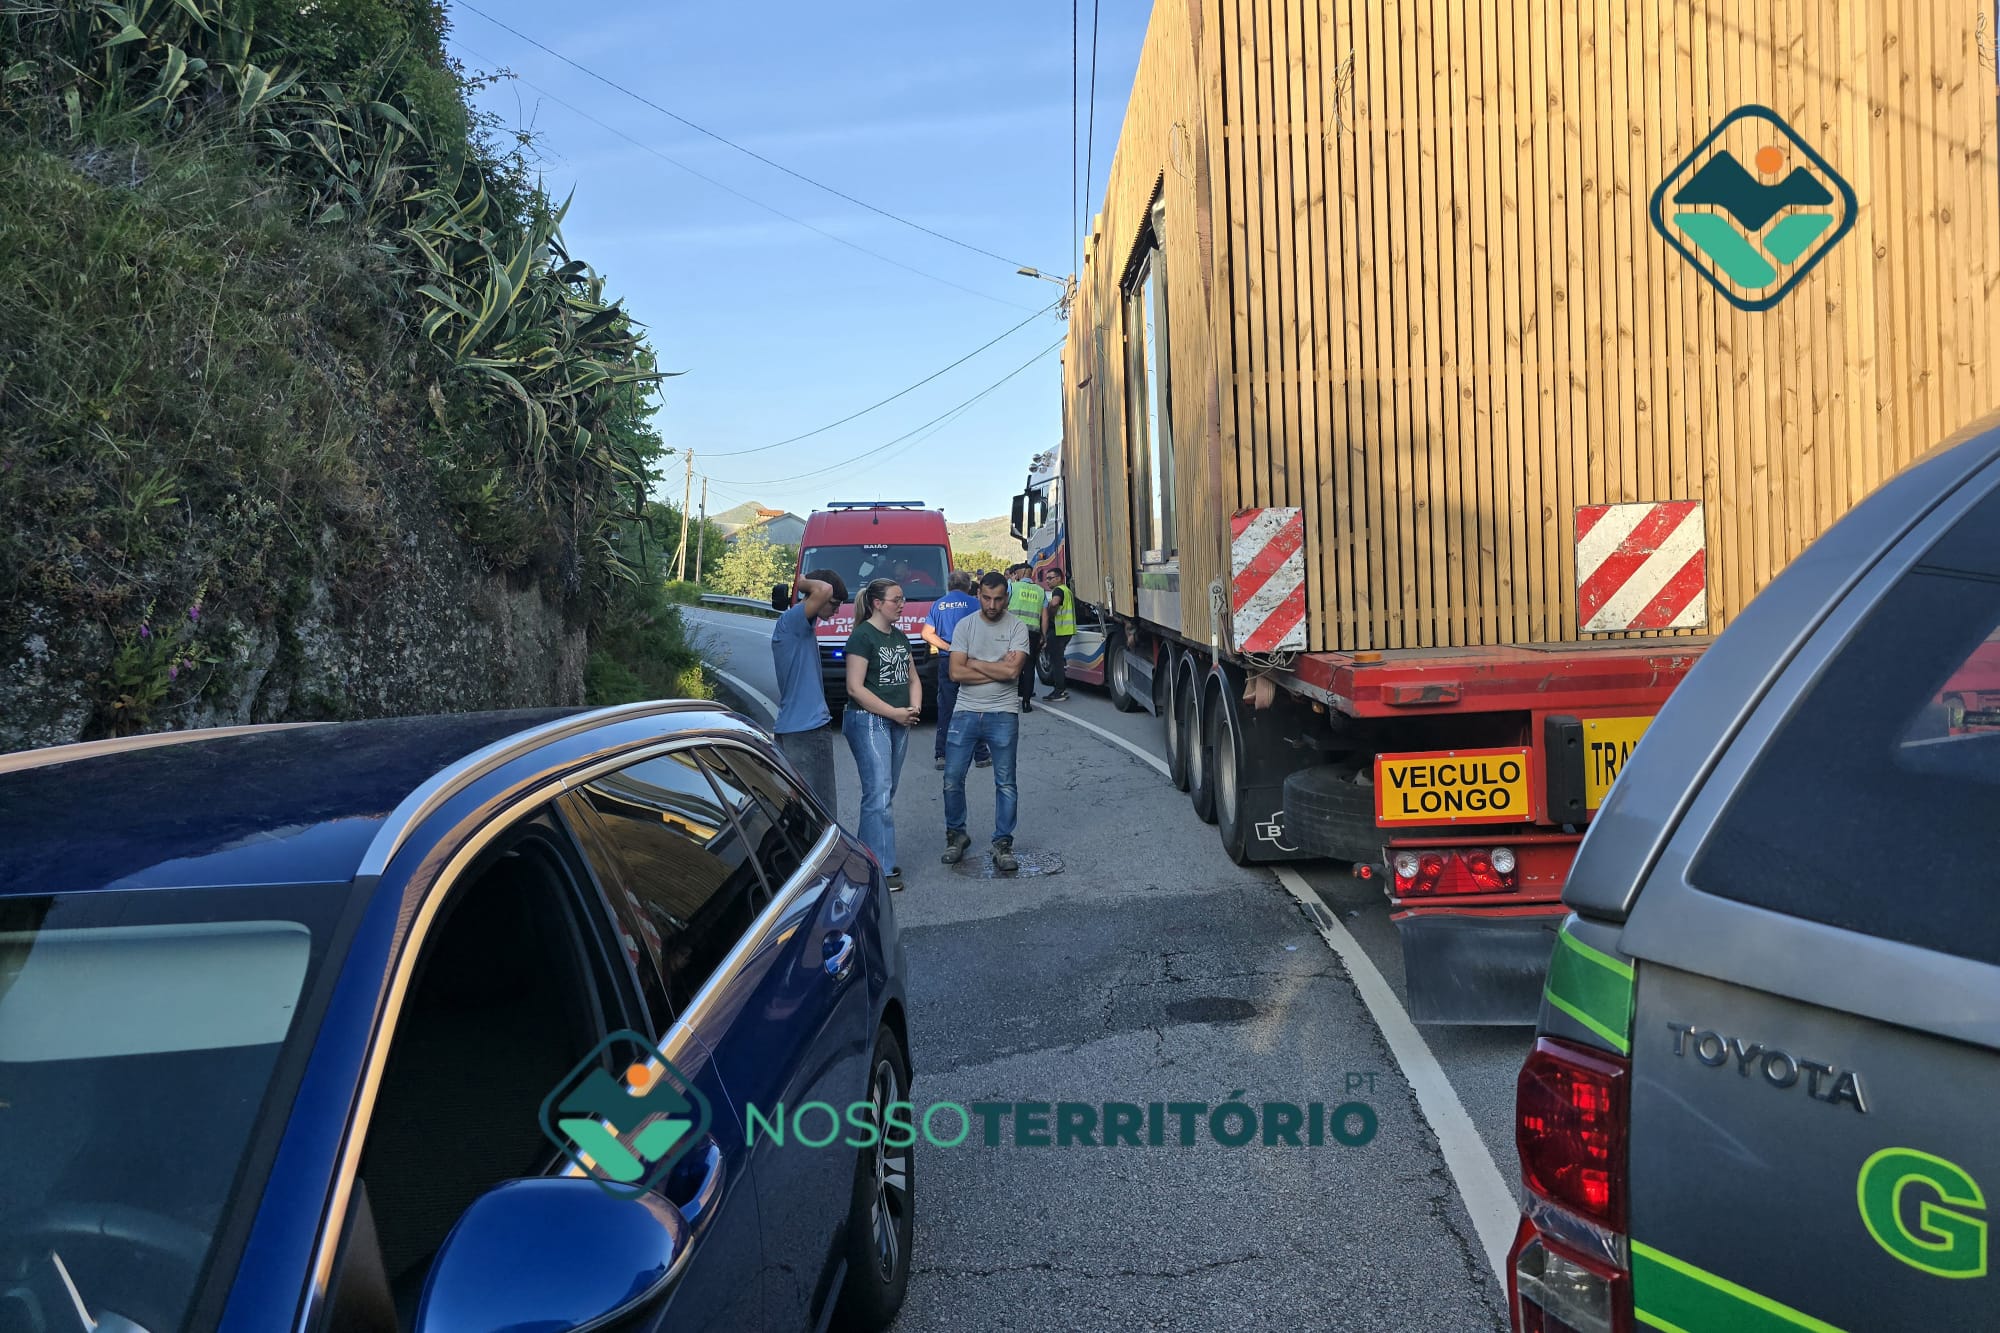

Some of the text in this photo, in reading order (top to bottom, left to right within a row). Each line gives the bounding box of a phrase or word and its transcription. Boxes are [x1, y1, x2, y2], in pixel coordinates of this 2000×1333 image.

[1388, 760, 1521, 789] VEICULO
[1591, 741, 1637, 786] TRA
[1402, 787, 1511, 814] LONGO
[1667, 1022, 1869, 1114] TOYOTA
[1857, 1147, 1988, 1279] G
